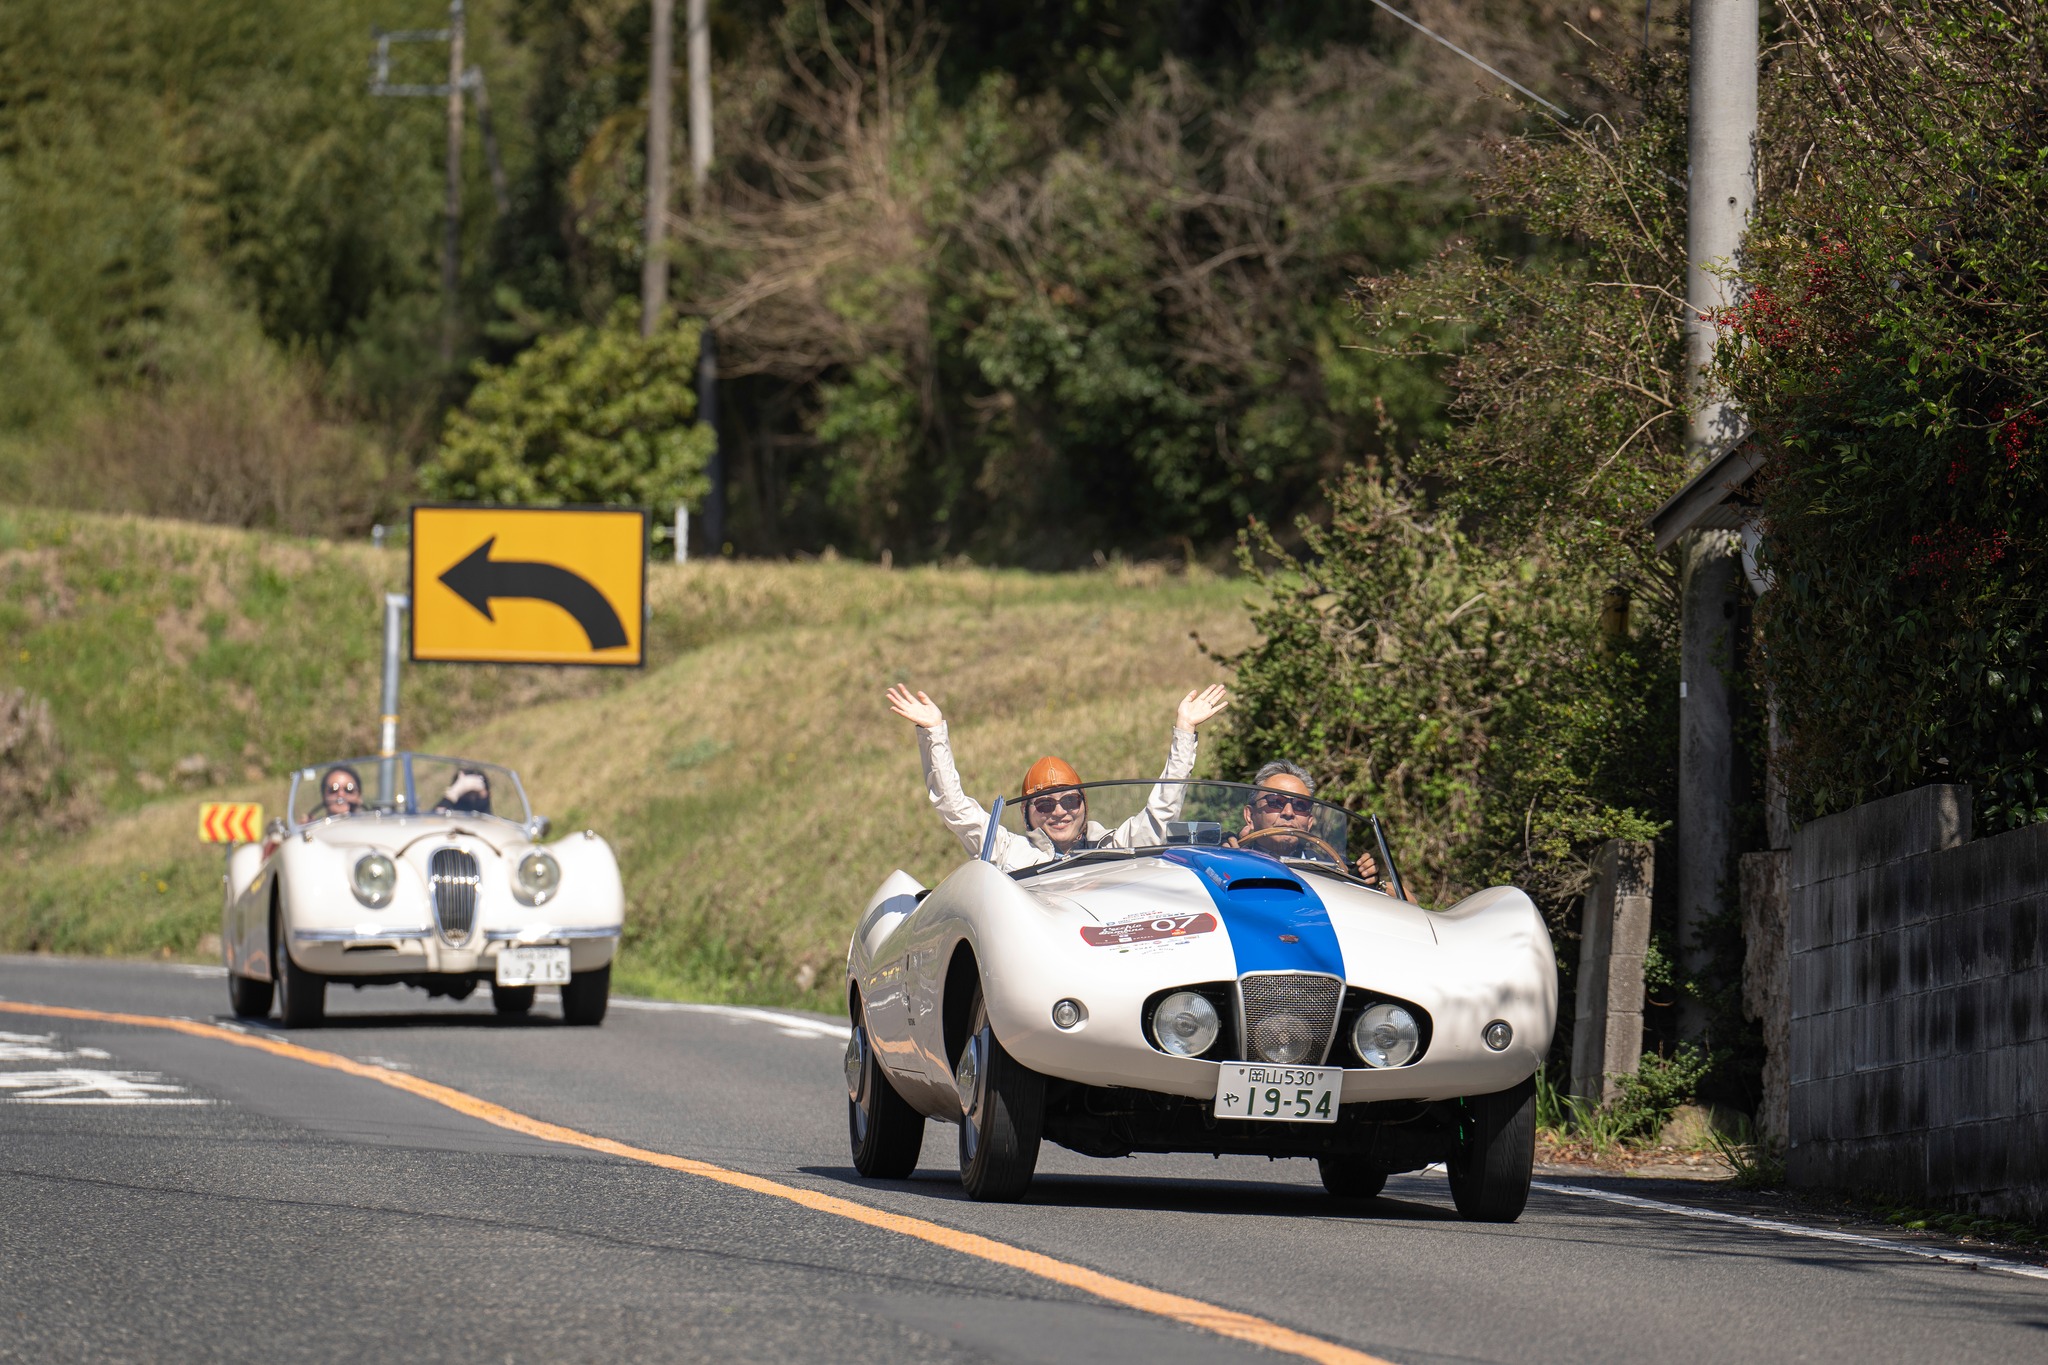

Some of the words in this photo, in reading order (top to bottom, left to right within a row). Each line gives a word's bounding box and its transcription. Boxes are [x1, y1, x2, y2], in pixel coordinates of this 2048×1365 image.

[1150, 914, 1200, 932] 07
[1223, 1092, 1240, 1107] や
[1246, 1087, 1332, 1118] 19-54
